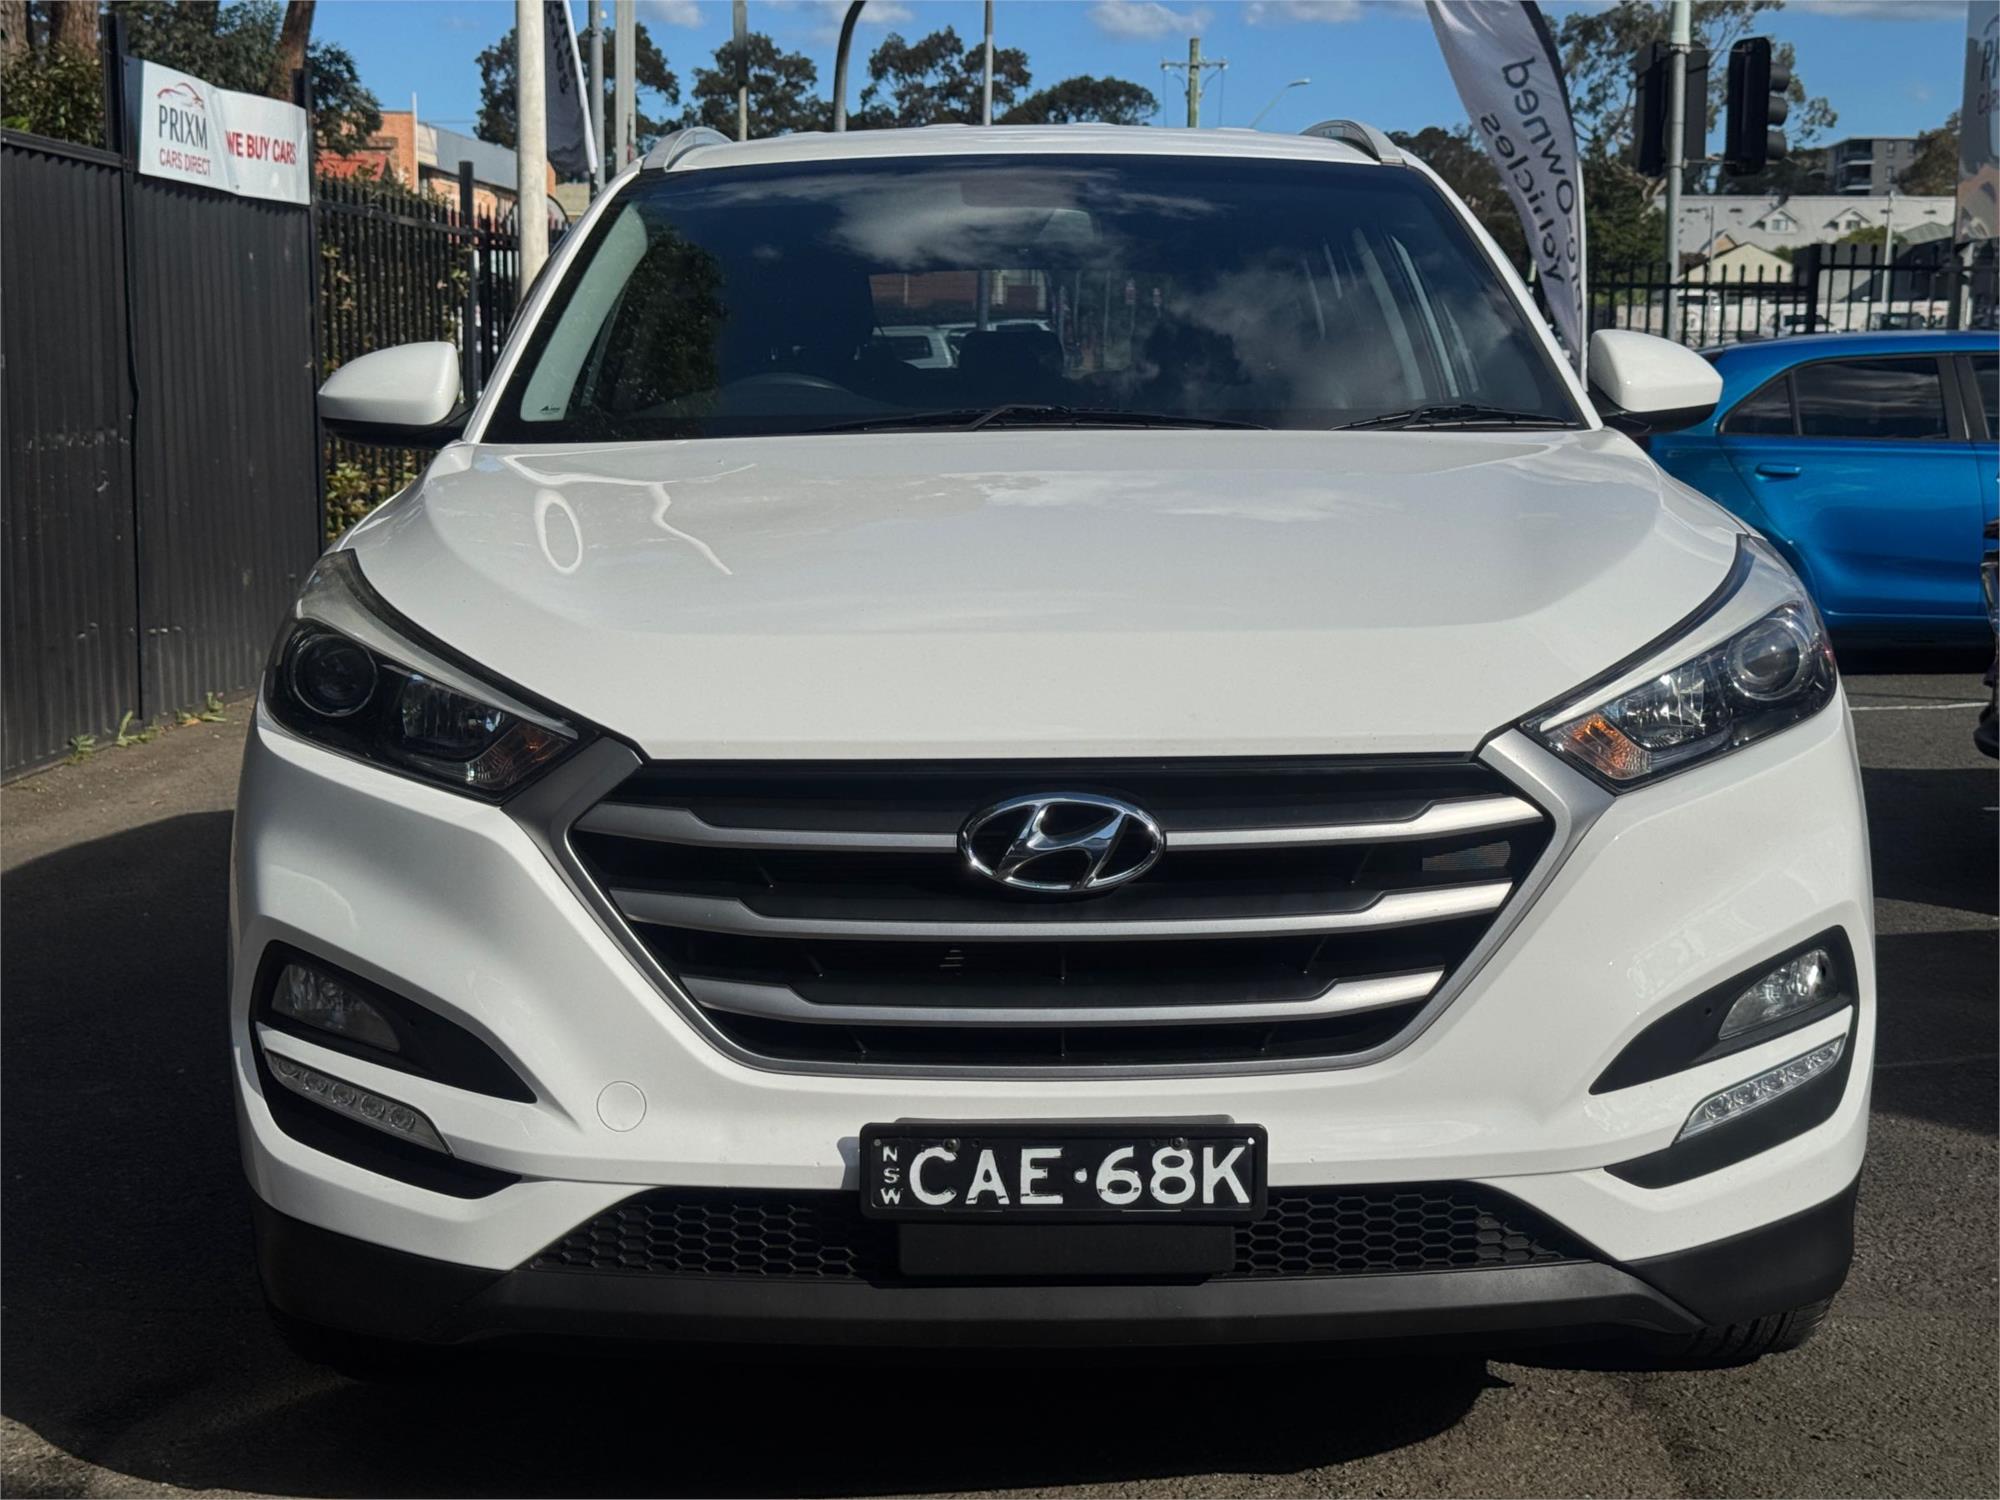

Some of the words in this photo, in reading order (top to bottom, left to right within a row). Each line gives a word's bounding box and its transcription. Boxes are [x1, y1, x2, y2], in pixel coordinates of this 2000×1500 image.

[159, 103, 208, 151] PRIXM
[160, 147, 183, 170] CARS
[184, 153, 211, 177] DIRECT
[225, 129, 244, 157] WE
[246, 133, 270, 161] BUY
[272, 138, 297, 166] CARS
